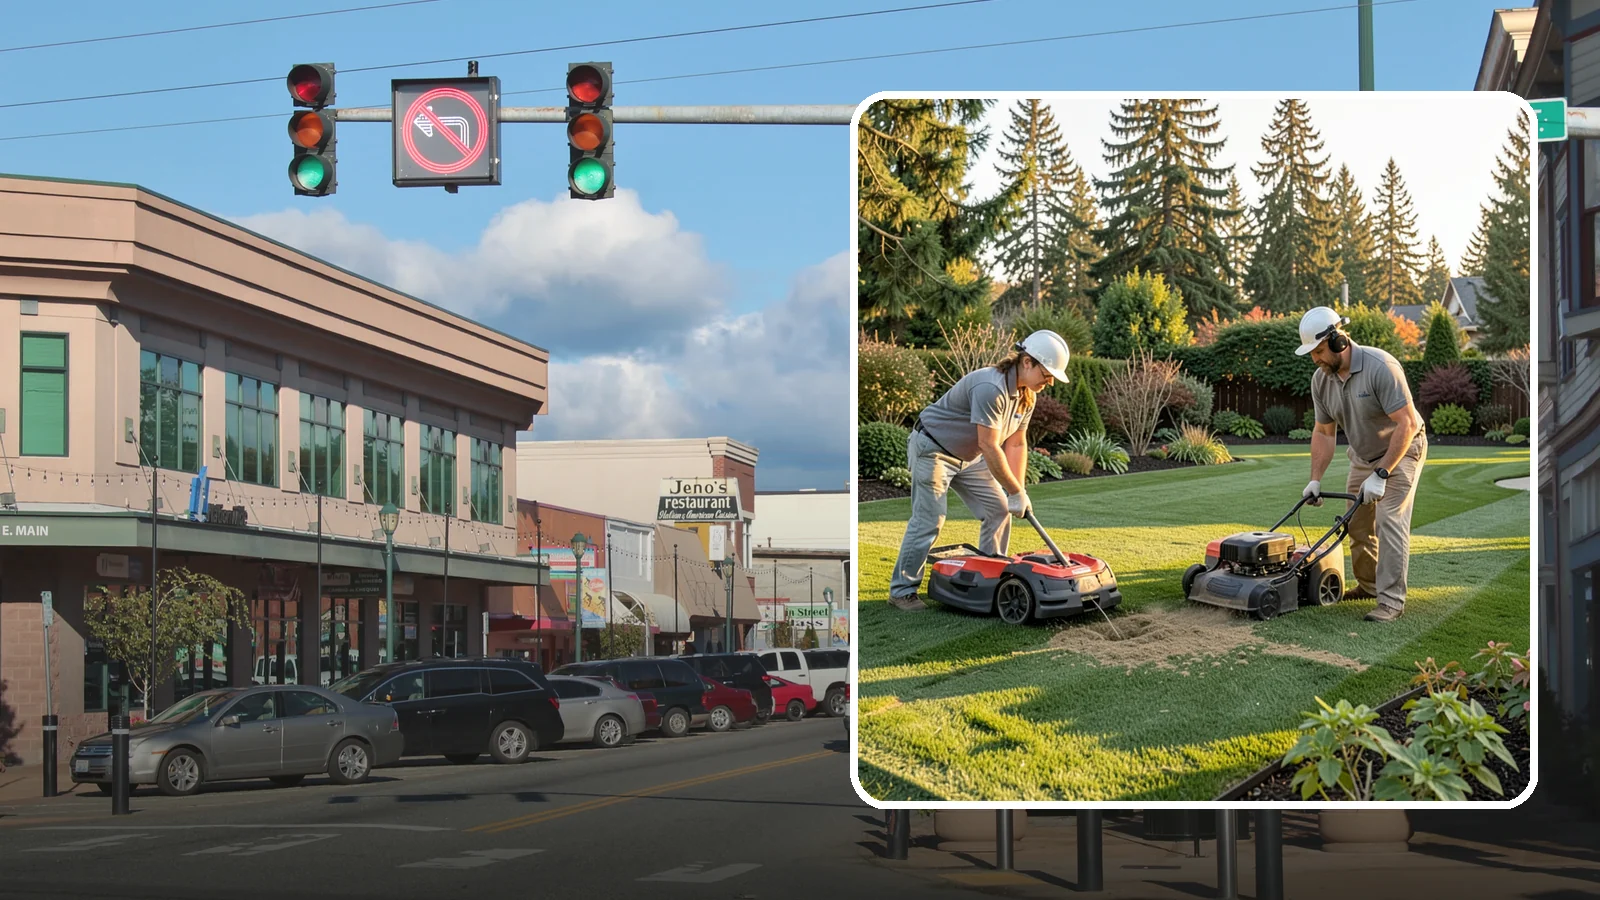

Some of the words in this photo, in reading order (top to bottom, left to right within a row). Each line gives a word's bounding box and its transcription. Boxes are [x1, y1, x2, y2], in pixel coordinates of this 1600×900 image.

[669, 480, 728, 495] Jeno's
[664, 496, 731, 509] restaurant
[685, 509, 714, 519] American
[714, 509, 738, 519] Cuisine
[2, 525, 13, 536] E.
[15, 525, 49, 536] MAIN
[797, 607, 828, 617] Street
[787, 619, 824, 627] lass
